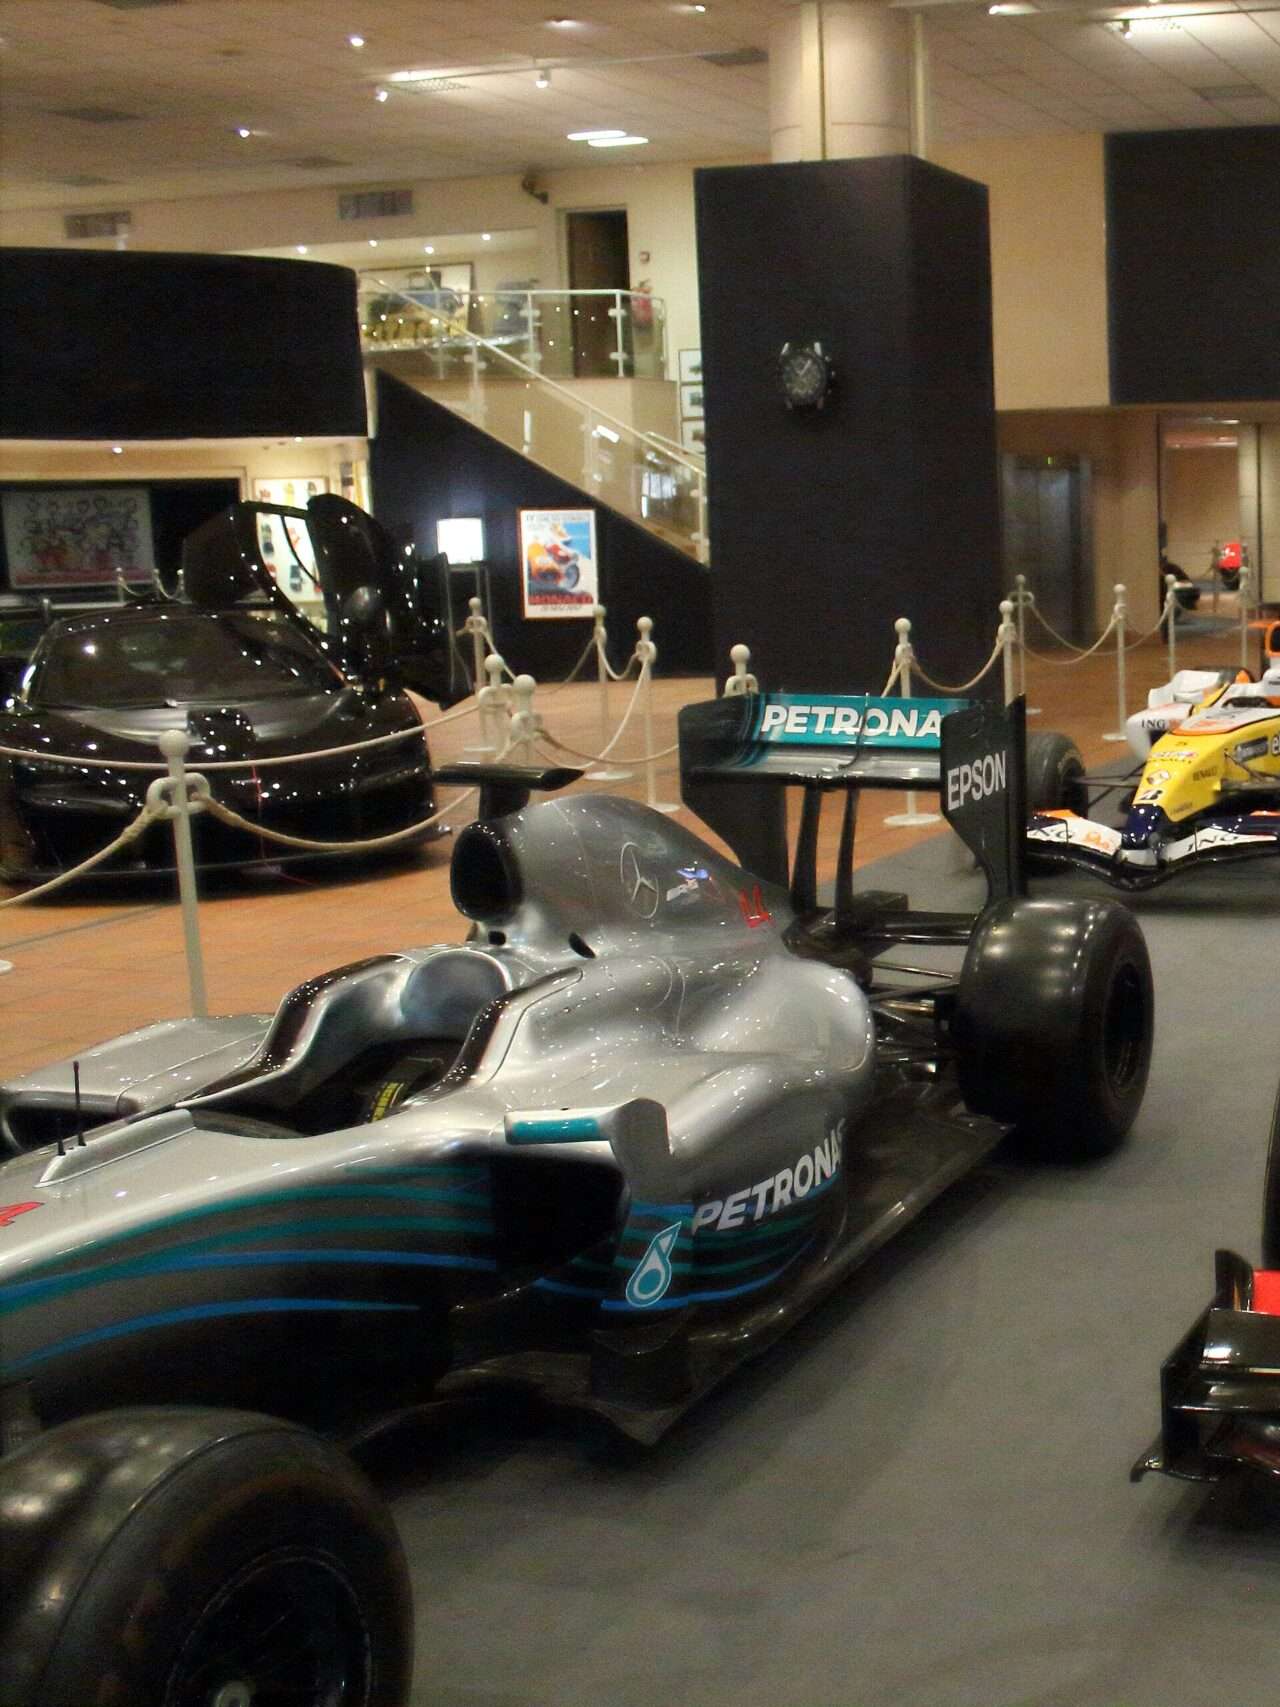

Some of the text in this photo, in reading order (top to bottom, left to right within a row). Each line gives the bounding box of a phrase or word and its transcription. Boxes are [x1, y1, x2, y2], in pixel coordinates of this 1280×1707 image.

[760, 704, 941, 738] PETRONA
[1141, 719, 1166, 729] ING
[946, 750, 1007, 811] EPSON
